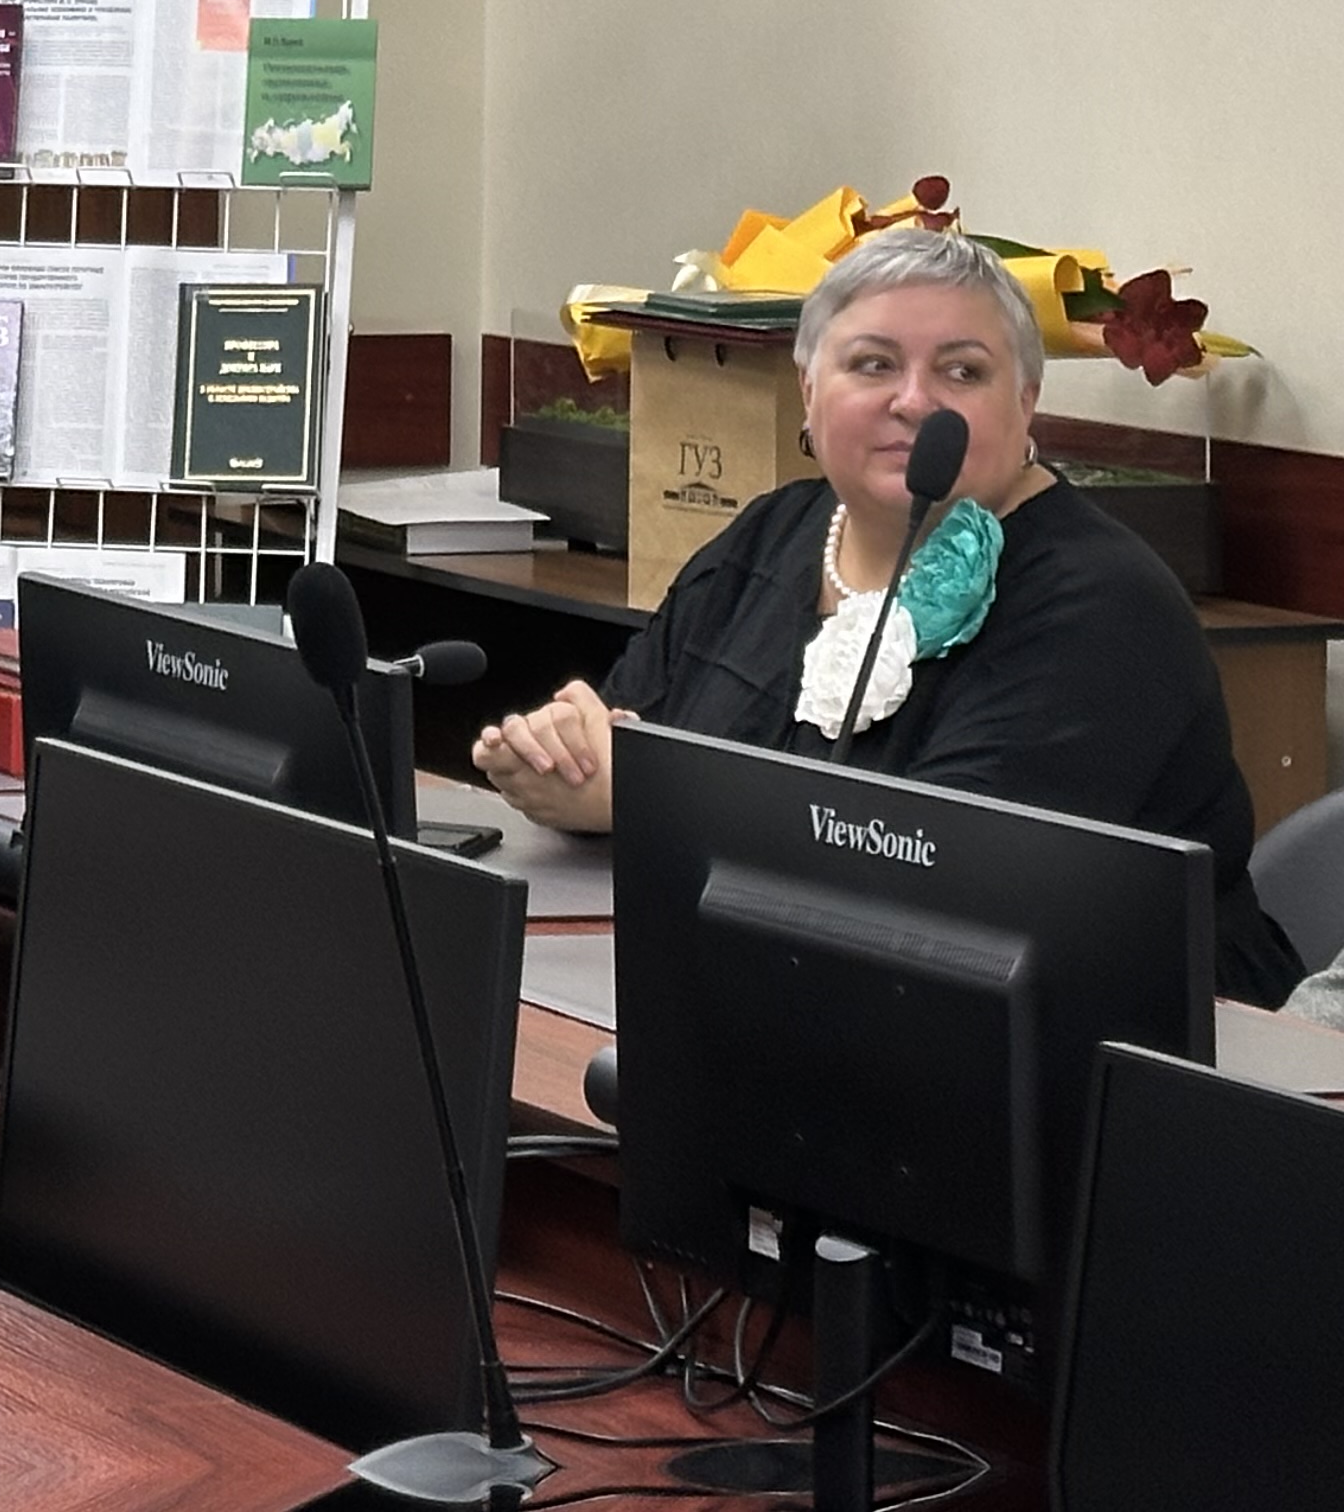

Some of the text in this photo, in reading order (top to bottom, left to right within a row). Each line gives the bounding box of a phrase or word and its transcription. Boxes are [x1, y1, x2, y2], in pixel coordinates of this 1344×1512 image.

[679, 442, 722, 479] ГУЗ
[146, 639, 229, 691] ViewSonic
[809, 804, 936, 867] ViewSonic
